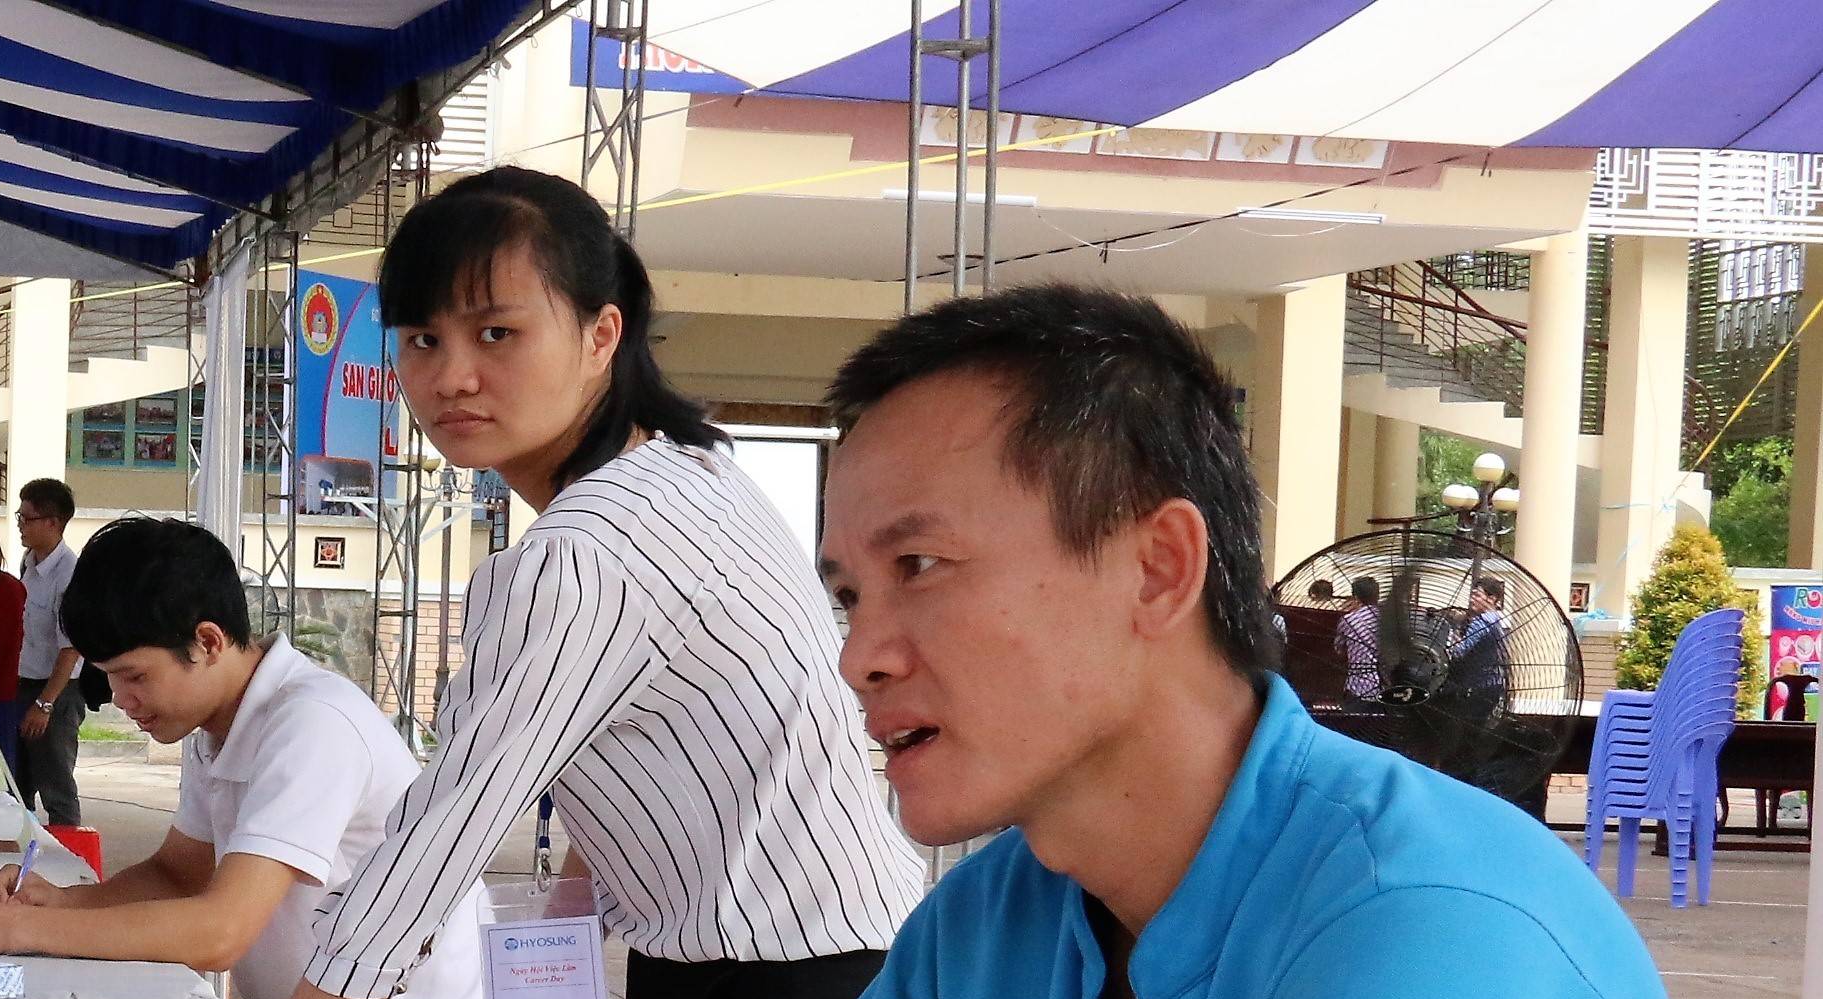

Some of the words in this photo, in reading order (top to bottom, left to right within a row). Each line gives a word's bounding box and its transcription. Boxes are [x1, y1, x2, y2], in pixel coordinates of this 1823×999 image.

[368, 364, 396, 402] GIO
[385, 427, 399, 457] L
[520, 935, 576, 948] HYOSUNG
[524, 976, 549, 985] Career
[550, 975, 565, 984] Day
